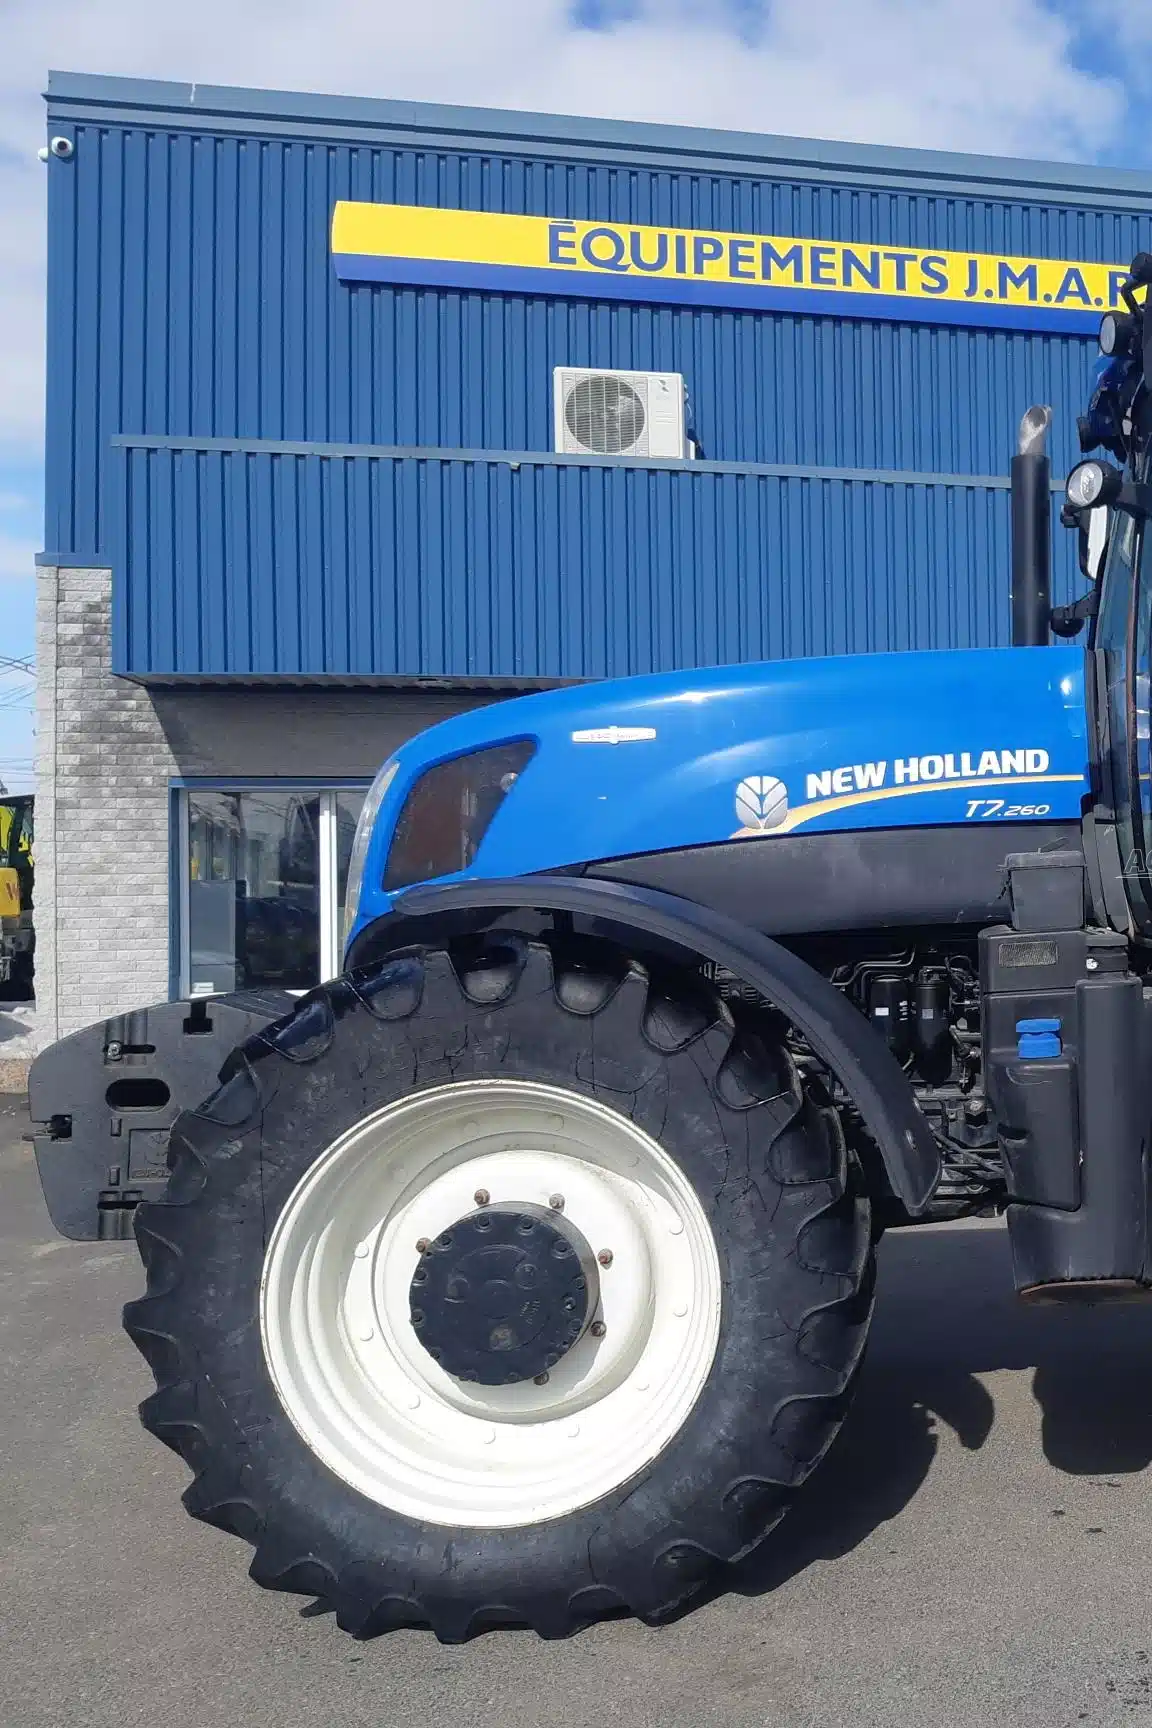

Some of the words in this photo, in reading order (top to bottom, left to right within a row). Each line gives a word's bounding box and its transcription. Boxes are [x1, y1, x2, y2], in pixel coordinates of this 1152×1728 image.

[807, 761, 887, 799] NEW
[894, 749, 1050, 784] HOLLAND
[965, 799, 1050, 818] T7.260
